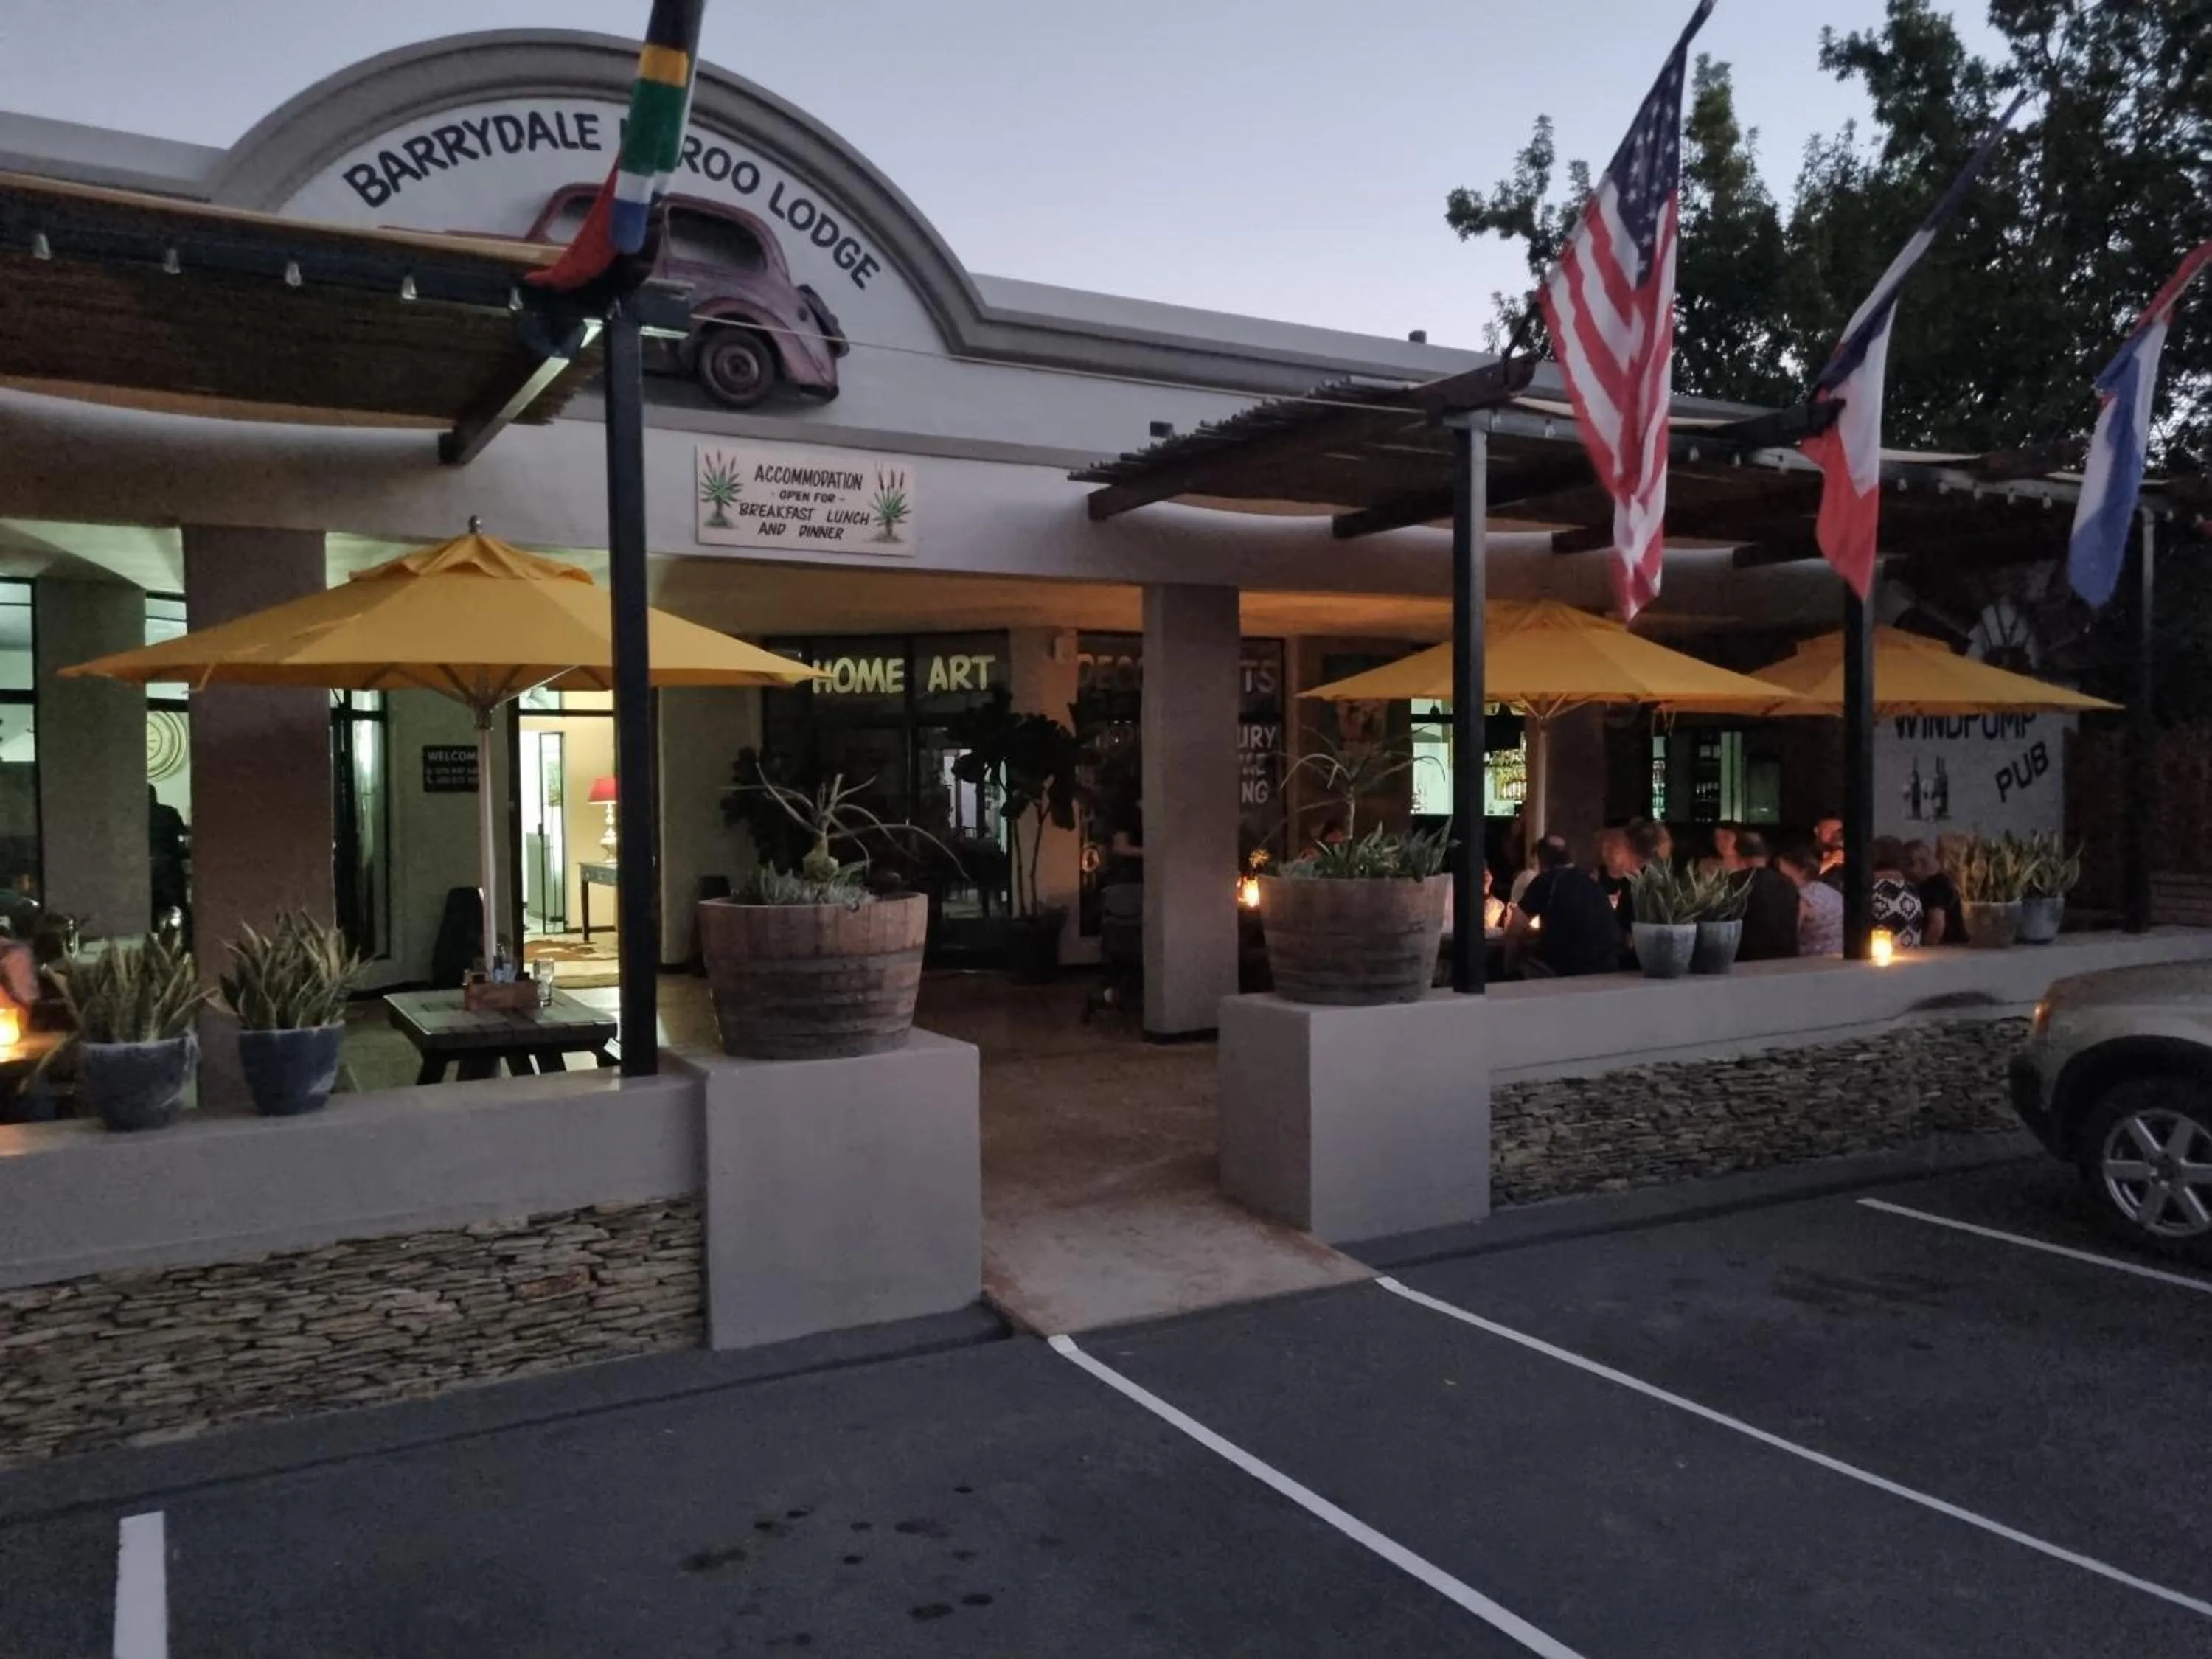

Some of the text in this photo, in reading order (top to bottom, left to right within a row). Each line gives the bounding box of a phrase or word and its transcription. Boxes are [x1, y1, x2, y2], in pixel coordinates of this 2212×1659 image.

[343, 110, 882, 290] BARRYDALE ROO LODGE
[754, 464, 863, 490] ACCOMMODATION
[779, 490, 835, 503] OPEN FOR
[739, 502, 870, 526] BREAKFAST LUNCH
[757, 521, 844, 540] AND DINNER
[813, 654, 995, 694] HOME ART
[427, 748, 478, 762] WELCOM
[1995, 740, 2050, 803] PUB
